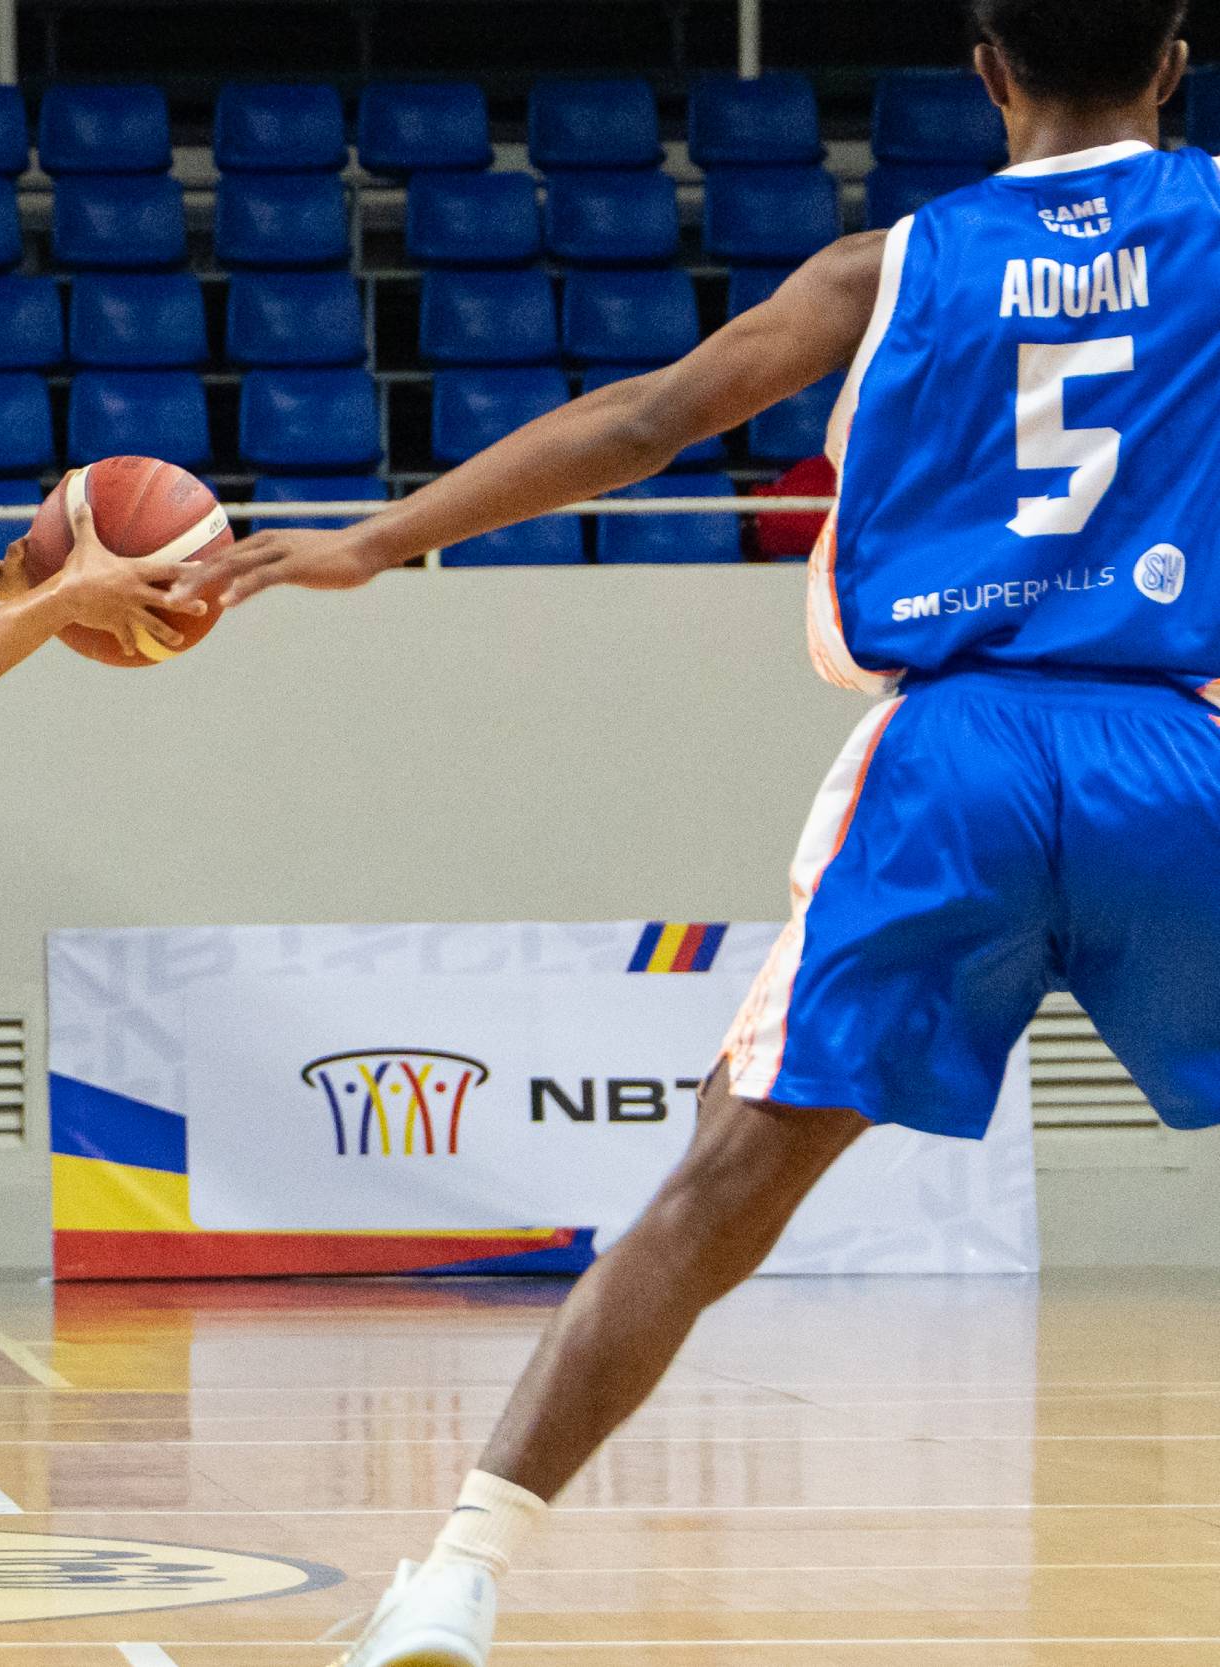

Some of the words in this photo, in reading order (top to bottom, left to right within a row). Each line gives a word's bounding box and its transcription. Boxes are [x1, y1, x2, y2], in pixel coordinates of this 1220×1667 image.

[1038, 197, 1108, 222] GAME
[999, 246, 1149, 318] ADUAN
[1005, 335, 1134, 537] 5
[943, 566, 1116, 614] SUPERALLS
